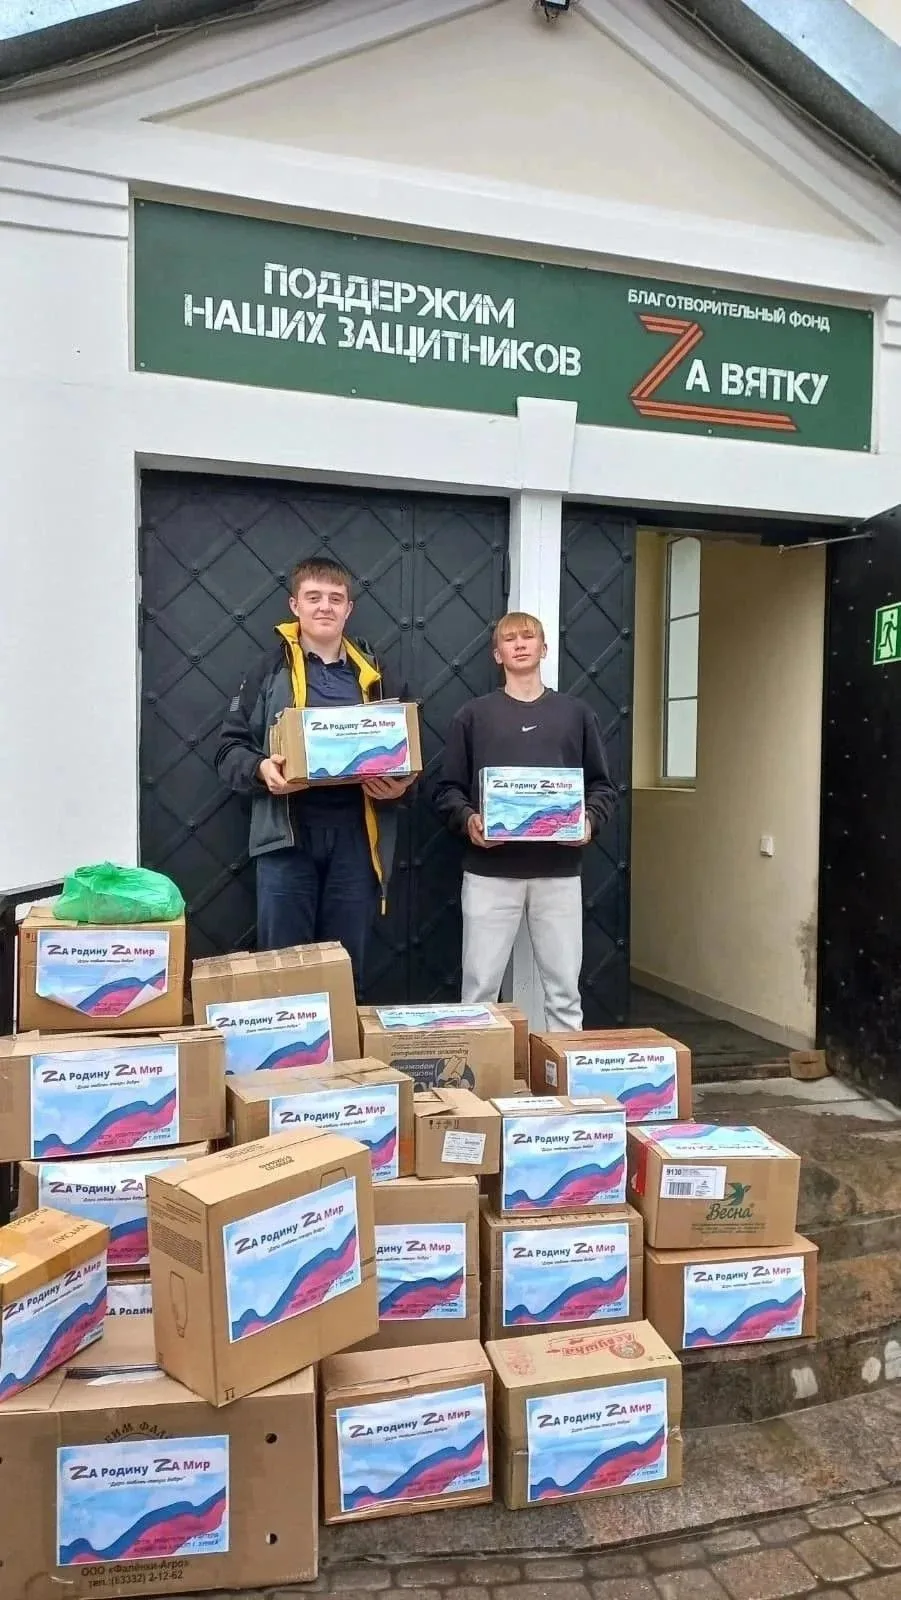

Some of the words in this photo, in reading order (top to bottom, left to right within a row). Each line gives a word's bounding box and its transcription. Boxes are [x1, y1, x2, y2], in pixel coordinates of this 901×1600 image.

[264, 262, 516, 329] ПОДДЕРЖИМ
[628, 289, 786, 325] БЛАГОТВОРИТЕЛЬНЫЙ
[789, 307, 831, 333] ФОНД
[184, 294, 327, 345] НАШИХ
[338, 316, 582, 377] ЗАЩИТНИКОВ
[721, 362, 829, 405] ВЯТКУ
[71, 947, 108, 957] Родину
[133, 948, 155, 957] Мир
[239, 1016, 273, 1027] Родину
[297, 1011, 317, 1021] Мир
[595, 1057, 625, 1066] Родину
[646, 1054, 665, 1063] Мир
[69, 1070, 111, 1081] Родину
[139, 1065, 163, 1076] Мир
[304, 1111, 341, 1122] Родину
[365, 1105, 386, 1115] Мир
[535, 1134, 570, 1144] Родину
[593, 1132, 613, 1141] Мир
[666, 1168, 682, 1176] 9130
[76, 1184, 116, 1195] Родину
[706, 1203, 753, 1221] Весна
[261, 1223, 298, 1245] Родину
[324, 1204, 344, 1219] Мир
[376, 1244, 402, 1255] дину
[429, 1243, 451, 1253] Мир
[536, 1248, 571, 1258] Родину
[596, 1244, 615, 1254] Мир
[715, 1271, 748, 1281] Родину
[772, 1267, 791, 1276] Мир
[26, 1284, 61, 1307] Родину
[83, 1261, 101, 1273] Мир
[119, 1308, 152, 1316] Родин
[563, 1411, 602, 1424] Родину
[629, 1402, 652, 1414] Мир
[376, 1420, 418, 1433] Родину
[447, 1410, 471, 1421] Мир
[100, 1464, 149, 1478] Родину
[183, 1460, 211, 1472] Мир
[81, 1565, 106, 1577] ООО
